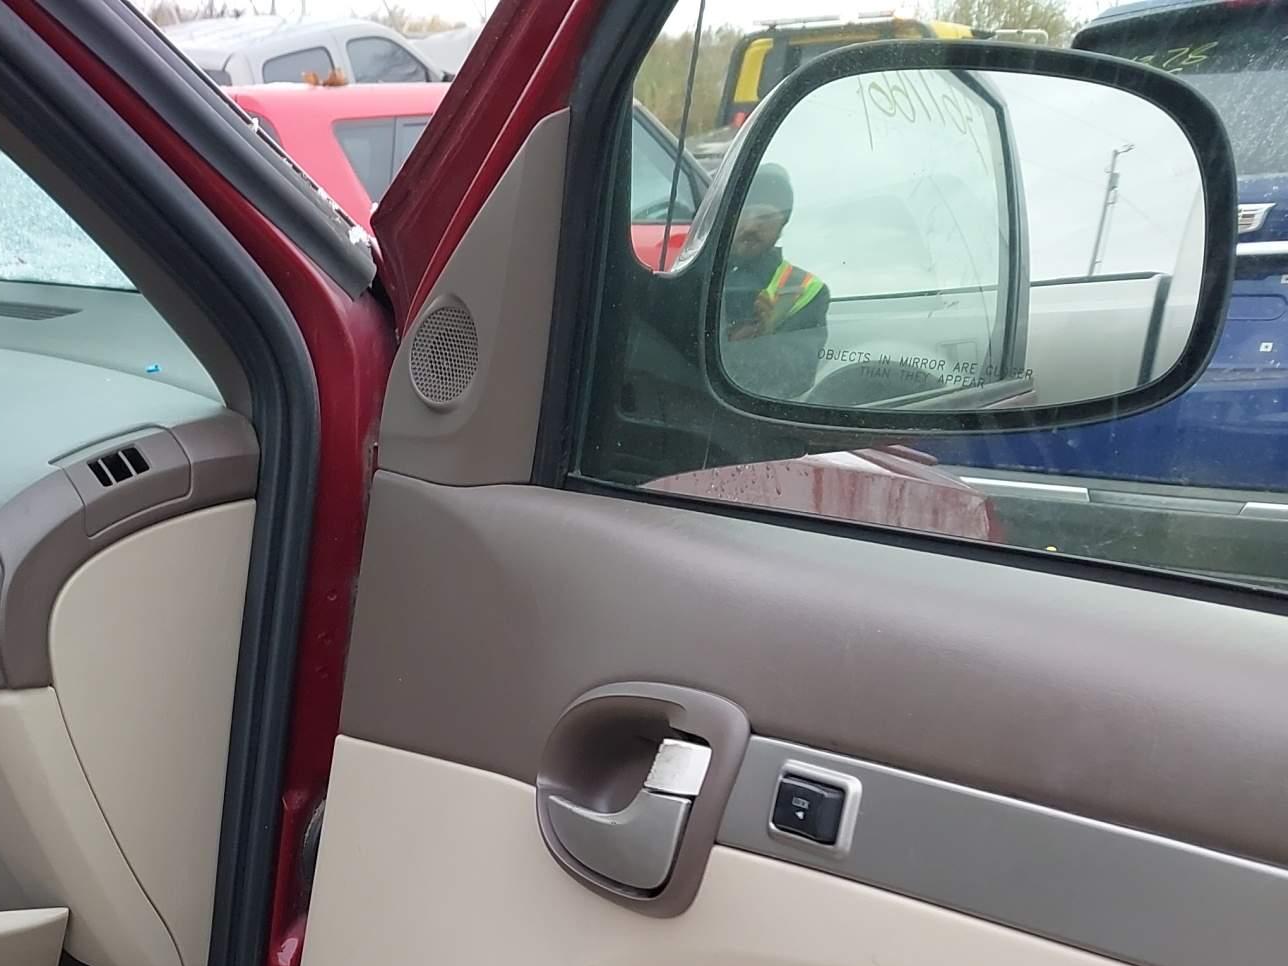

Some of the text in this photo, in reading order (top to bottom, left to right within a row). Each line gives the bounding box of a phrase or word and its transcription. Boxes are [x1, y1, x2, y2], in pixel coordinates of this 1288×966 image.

[817, 349, 871, 363] OBJECTS
[878, 352, 891, 365] IN
[899, 355, 946, 370] MIRROR
[953, 362, 979, 375] ARE
[860, 366, 985, 388] THAN THEY APPEAR
